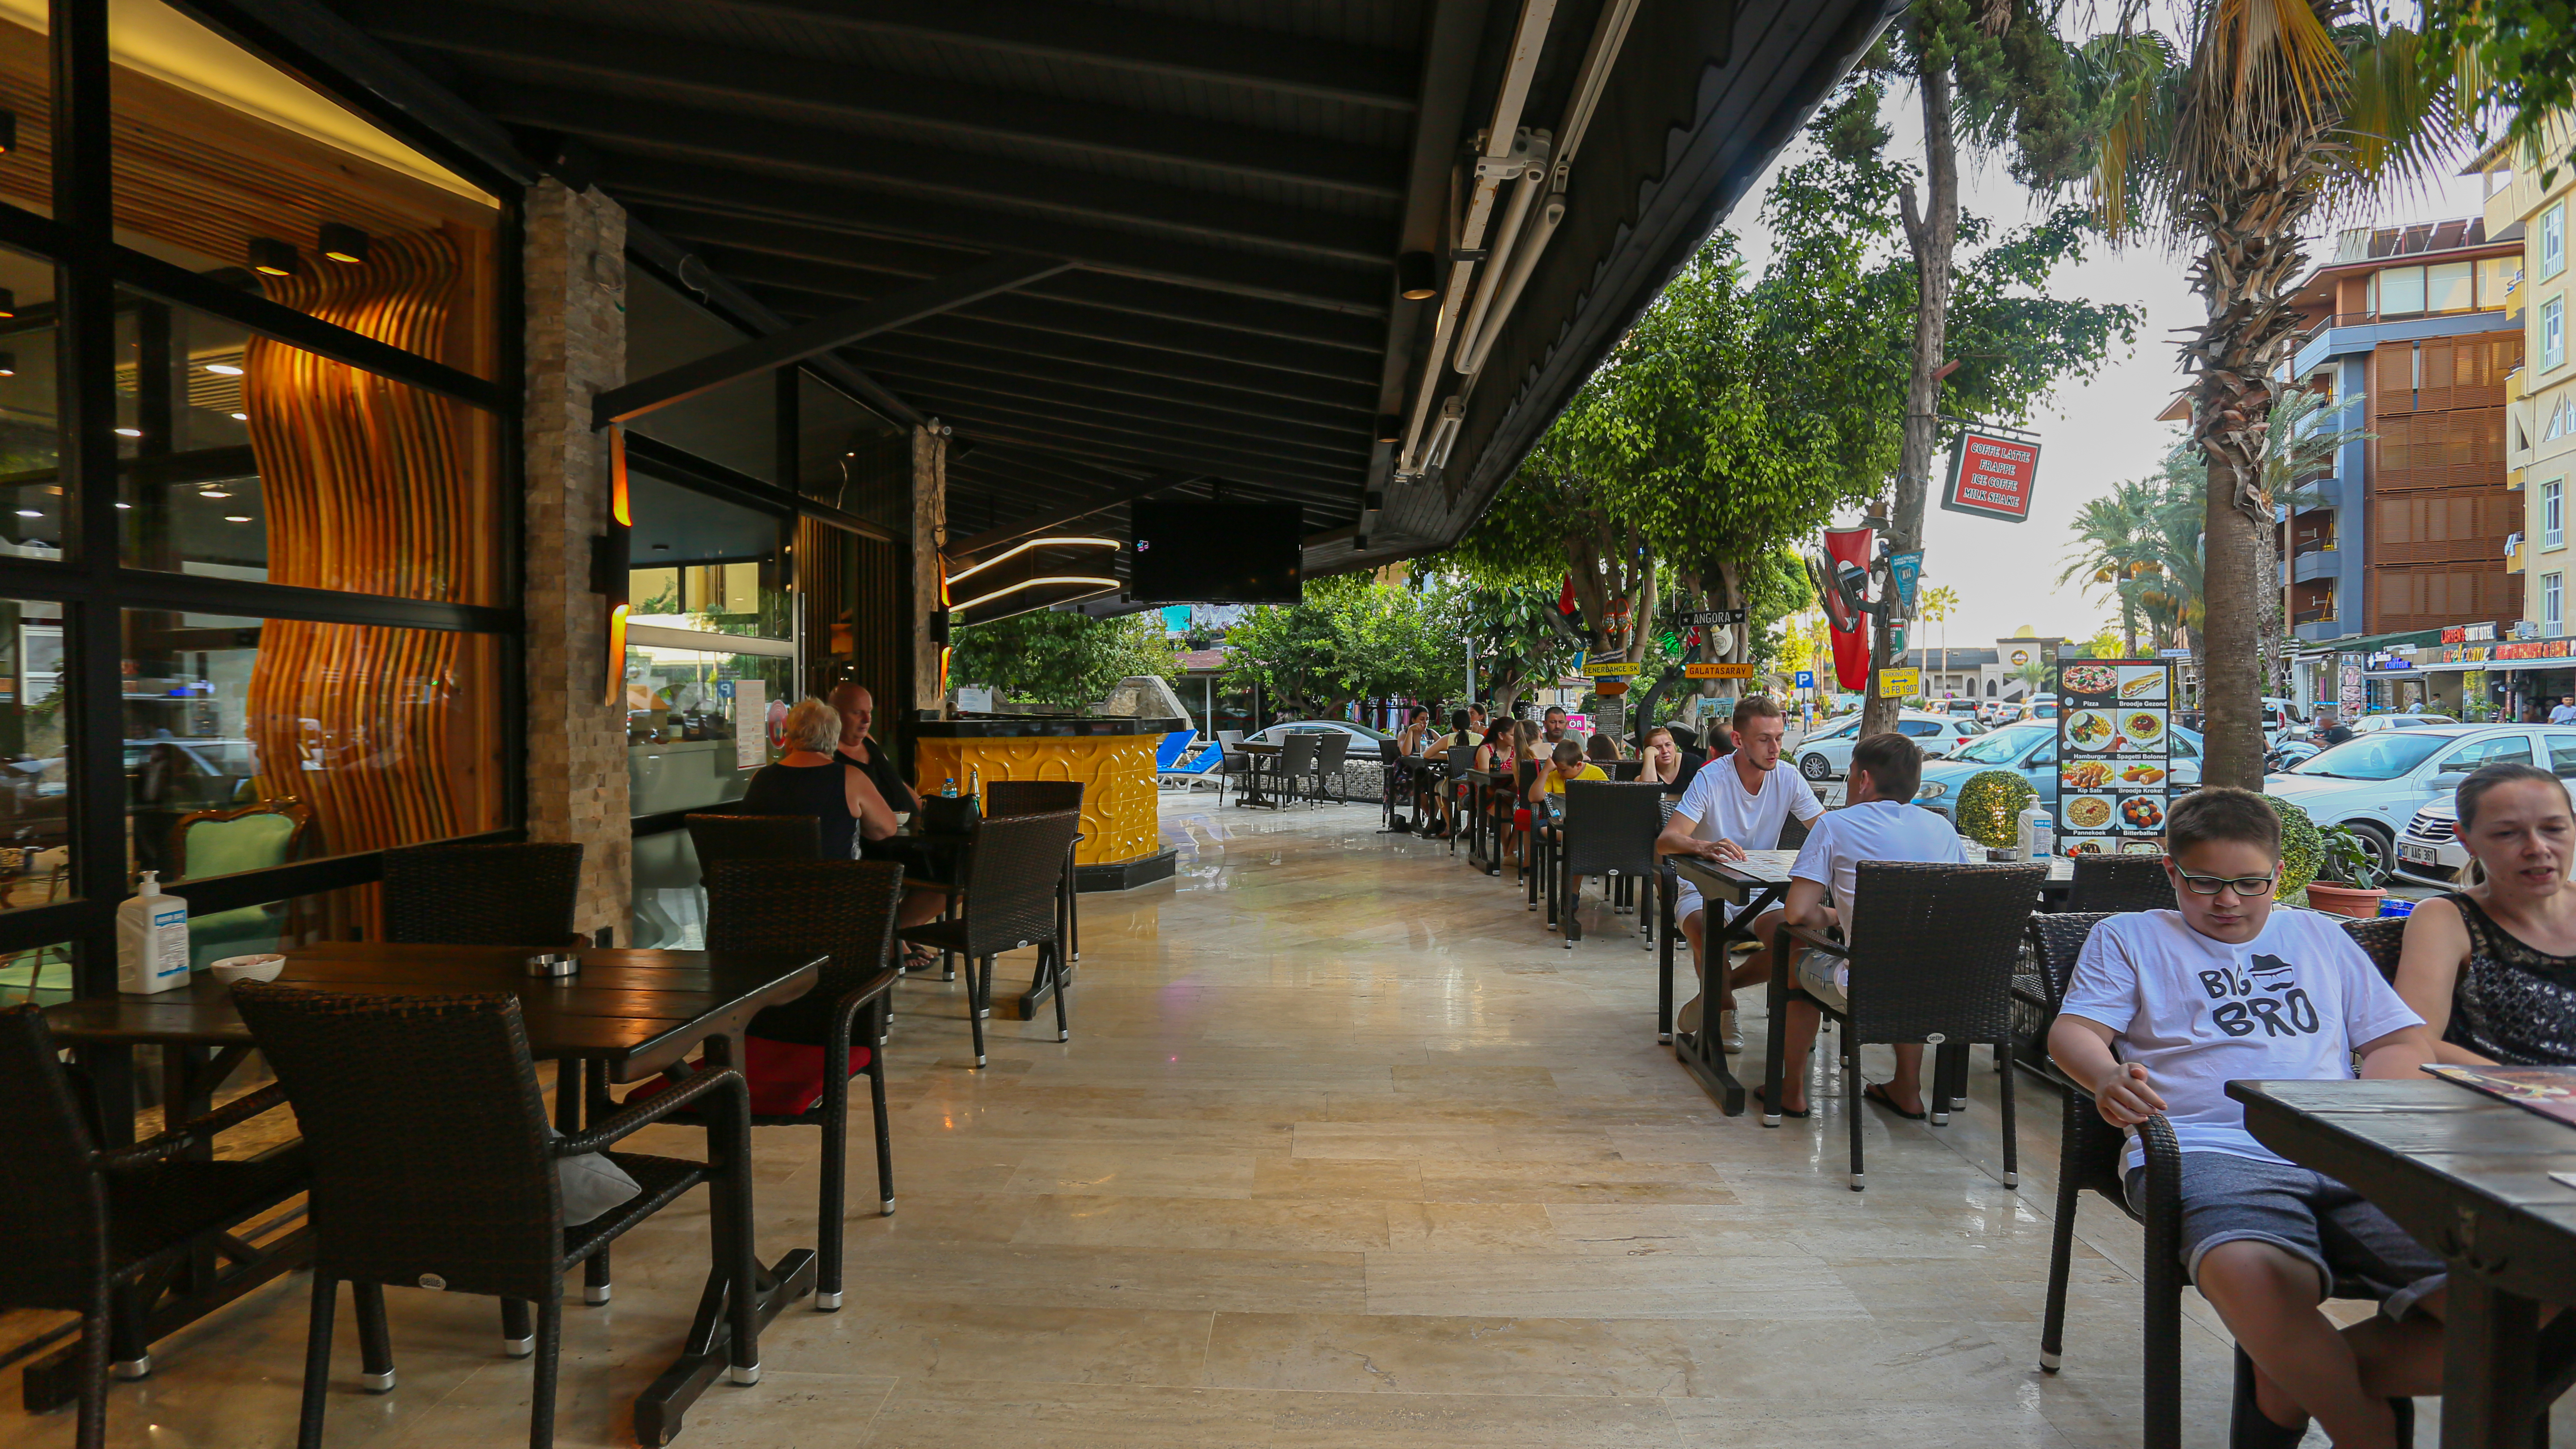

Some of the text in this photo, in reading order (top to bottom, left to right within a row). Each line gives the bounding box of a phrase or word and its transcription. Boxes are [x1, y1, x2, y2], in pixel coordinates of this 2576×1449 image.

[1971, 442, 2030, 462] COFFE LATTE
[1979, 459, 2016, 475] FRAPPE
[1971, 474, 2017, 491] ICE COFFE
[1963, 487, 2020, 507] MILK SHAKE
[1902, 568, 1911, 580] KSC
[1694, 612, 1730, 624] ANGORA
[2479, 625, 2494, 640] OTEL
[1799, 674, 1809, 685] P
[1882, 684, 1917, 695] 34 FB 1907
[2402, 845, 2433, 862] 07 AAG 361
[2198, 964, 2251, 999] BIG
[2212, 988, 2319, 1037] BRO
